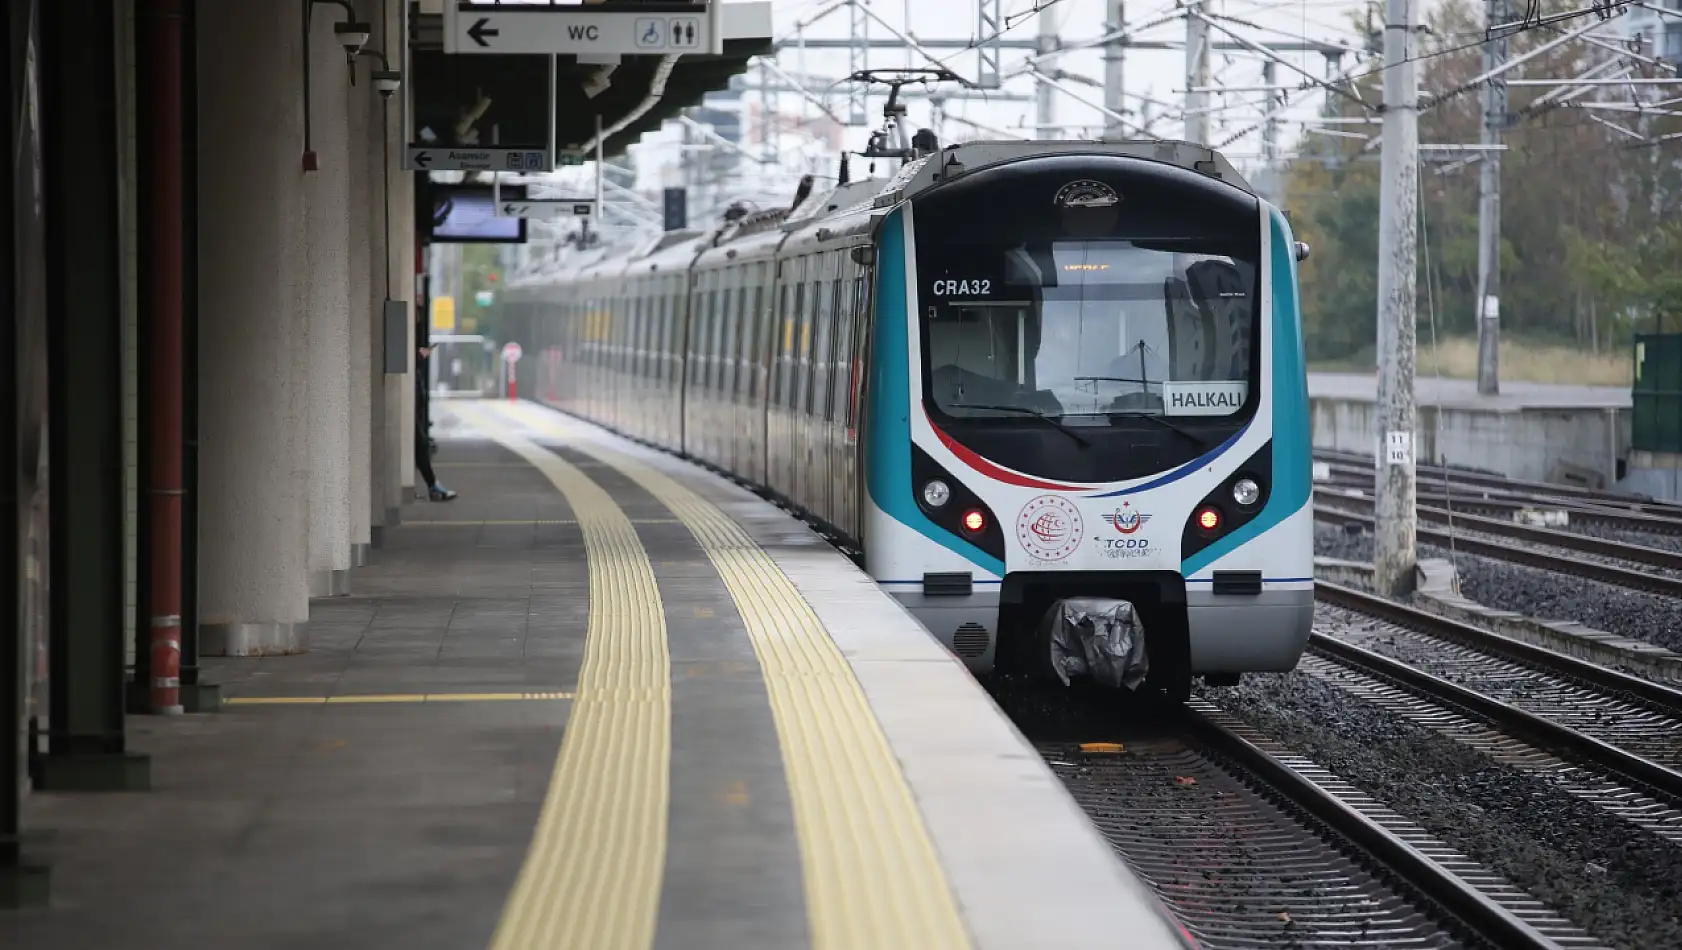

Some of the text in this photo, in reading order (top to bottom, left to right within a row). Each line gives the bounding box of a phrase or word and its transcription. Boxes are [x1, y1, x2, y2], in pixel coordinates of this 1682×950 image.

[568, 25, 599, 41] WC
[933, 279, 991, 295] CRA32
[1172, 391, 1241, 408] HALKALI
[1105, 539, 1149, 549] TCDD
